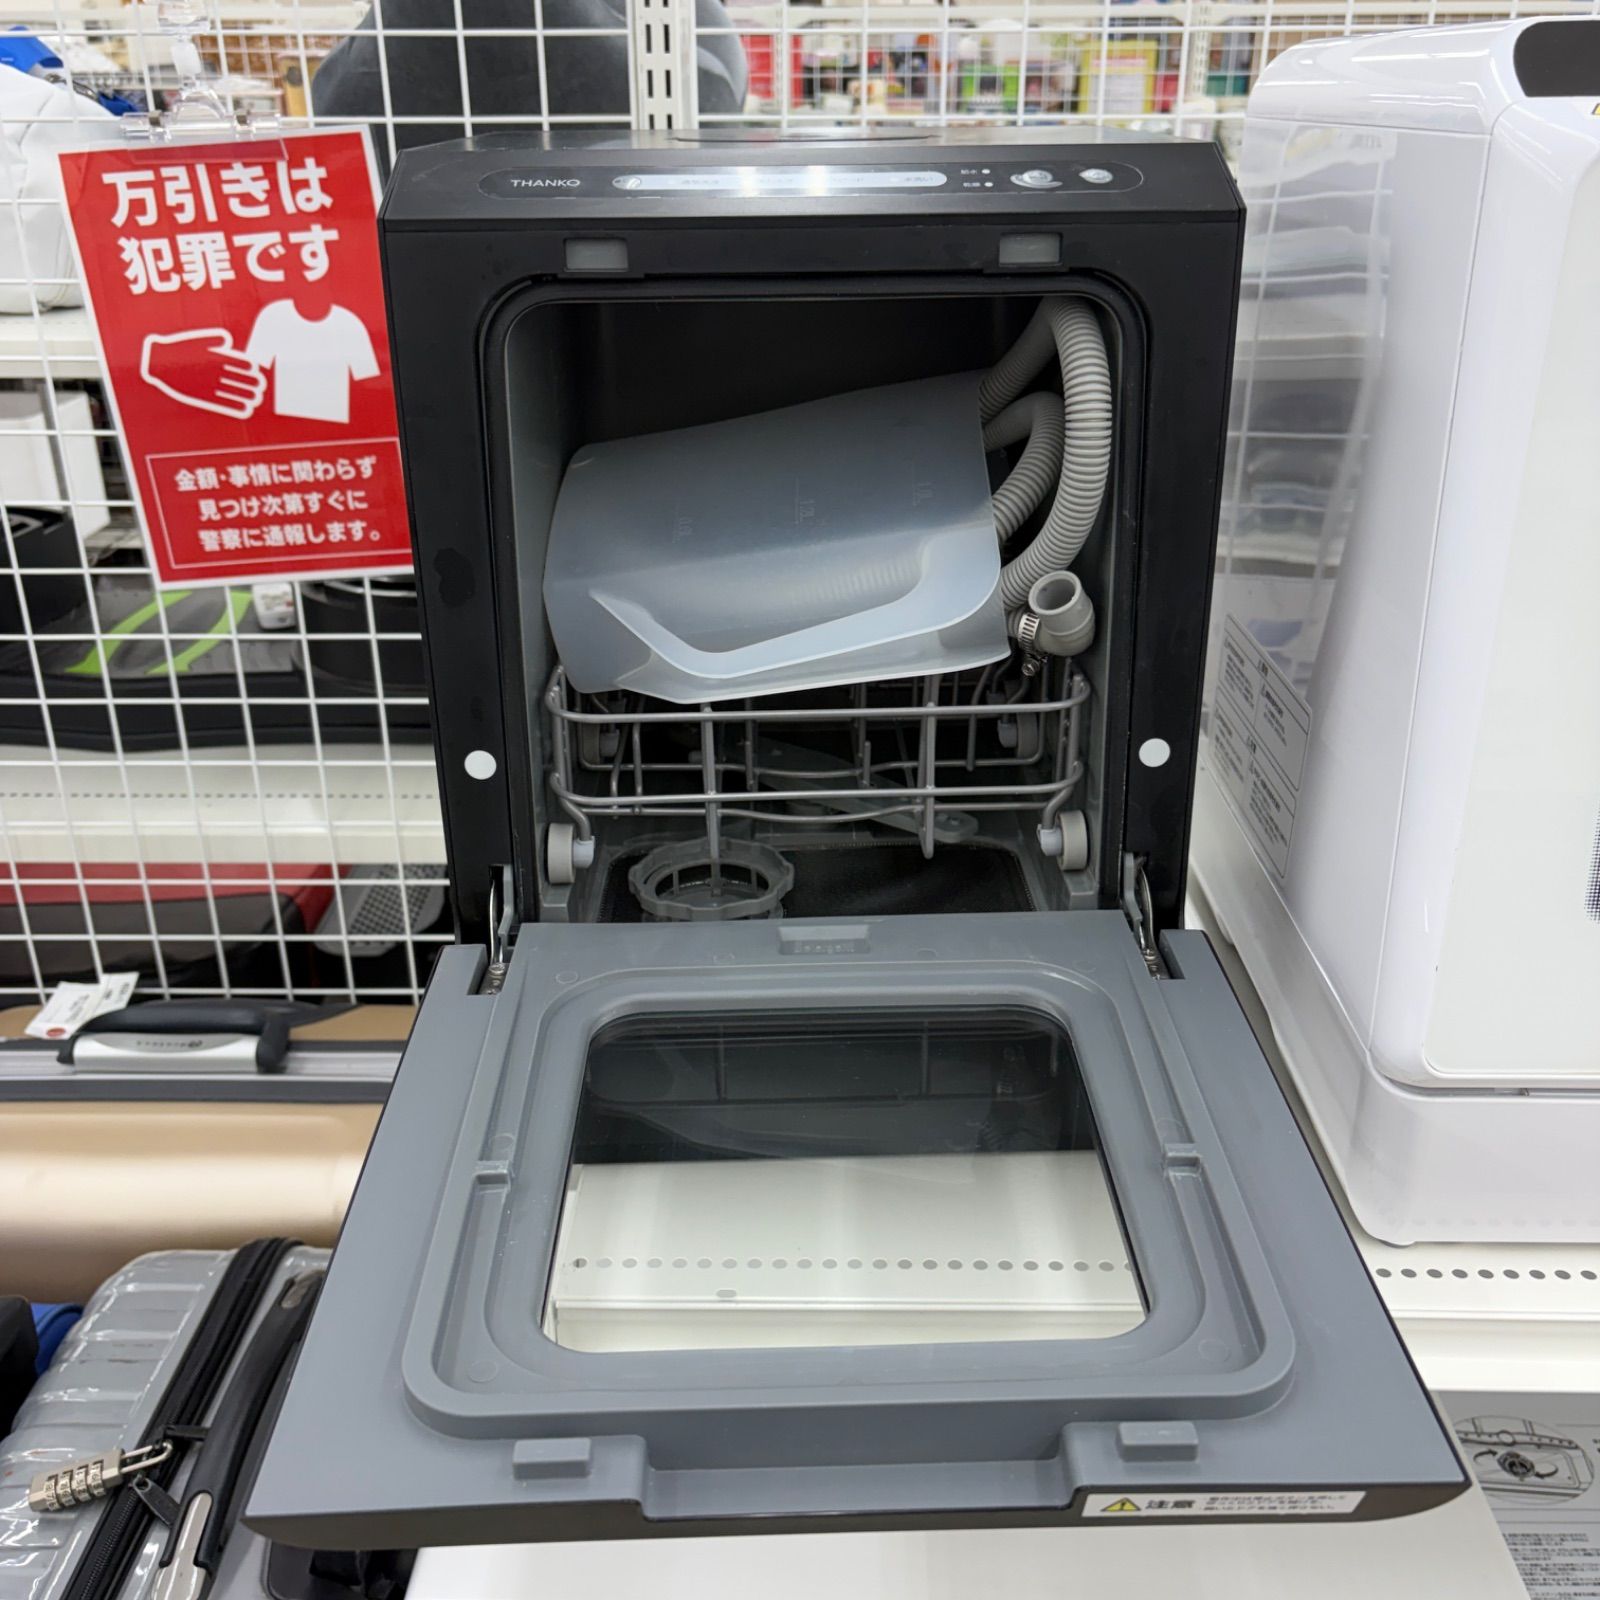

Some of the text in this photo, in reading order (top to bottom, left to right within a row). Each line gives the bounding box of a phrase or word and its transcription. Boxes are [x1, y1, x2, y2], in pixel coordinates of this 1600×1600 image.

[101, 157, 333, 228] 万引きは
[510, 179, 580, 187] THANKO
[117, 224, 339, 295] 犯罪です
[174, 455, 377, 491] 金額・事情に関わらず
[198, 490, 368, 521] 見つけ次第すぐに
[198, 520, 381, 552] 警察に通報します。
